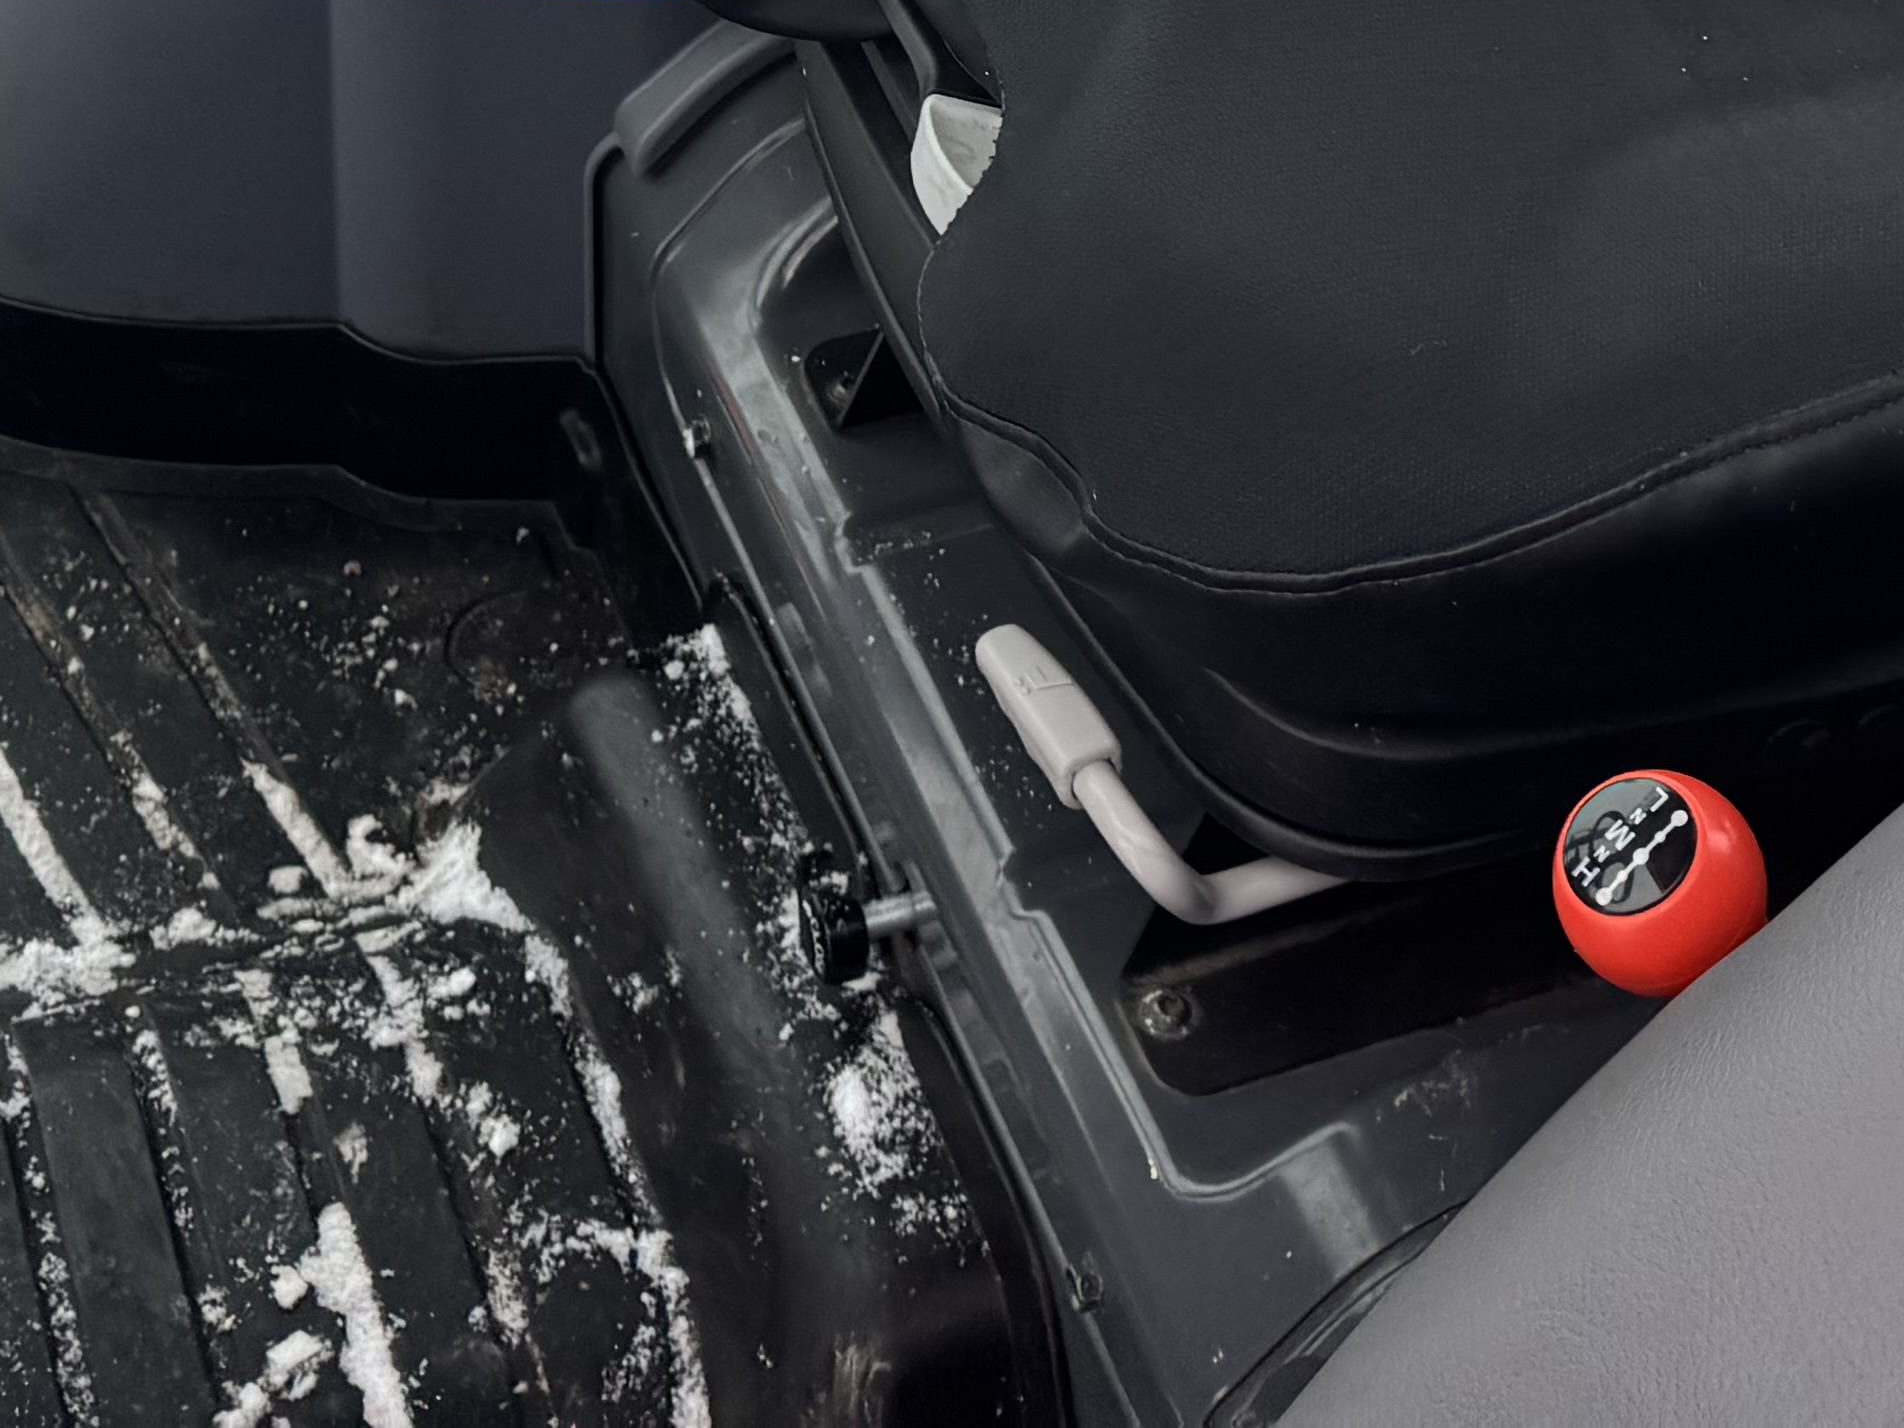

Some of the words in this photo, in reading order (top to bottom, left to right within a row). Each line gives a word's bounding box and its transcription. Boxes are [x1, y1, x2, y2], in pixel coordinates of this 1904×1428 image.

[1650, 786, 1669, 812] L
[1604, 819, 1636, 851] M
[1571, 857, 1600, 887] H
